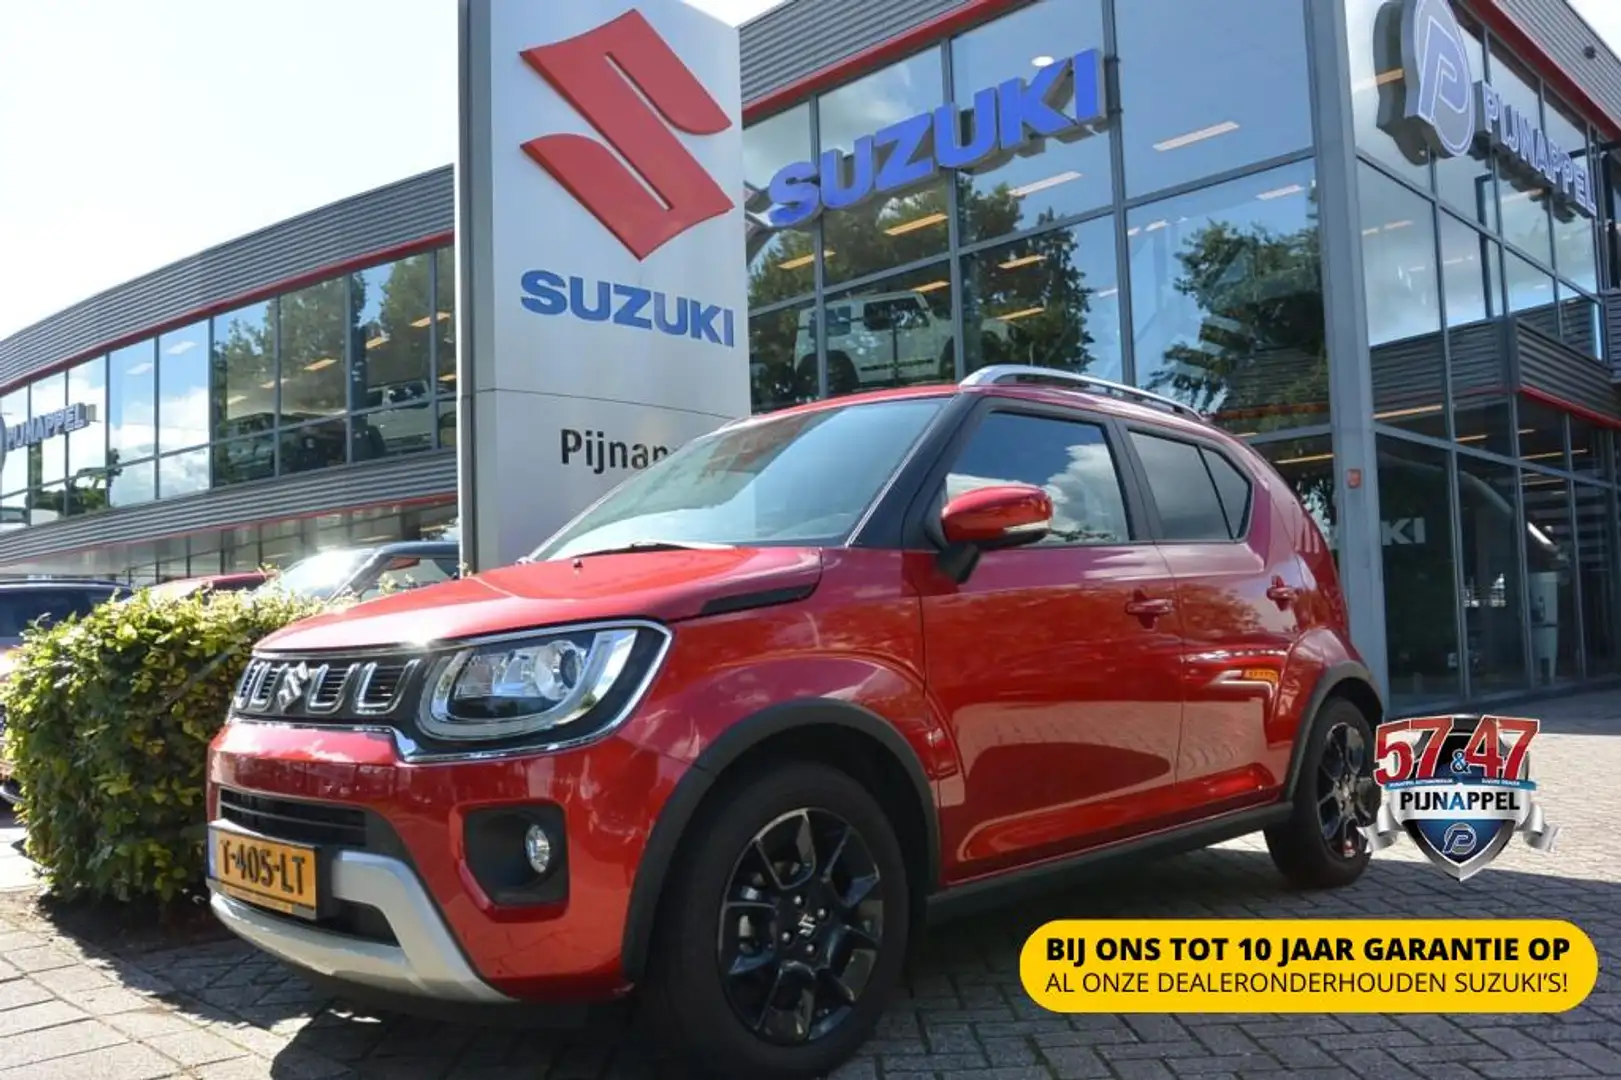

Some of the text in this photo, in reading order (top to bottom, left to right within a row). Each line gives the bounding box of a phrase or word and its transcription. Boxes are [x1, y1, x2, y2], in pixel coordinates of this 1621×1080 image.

[768, 48, 1103, 227] SUZUKI
[1480, 81, 1598, 217] PIJNAPPEL
[520, 269, 735, 348] SUZUKI
